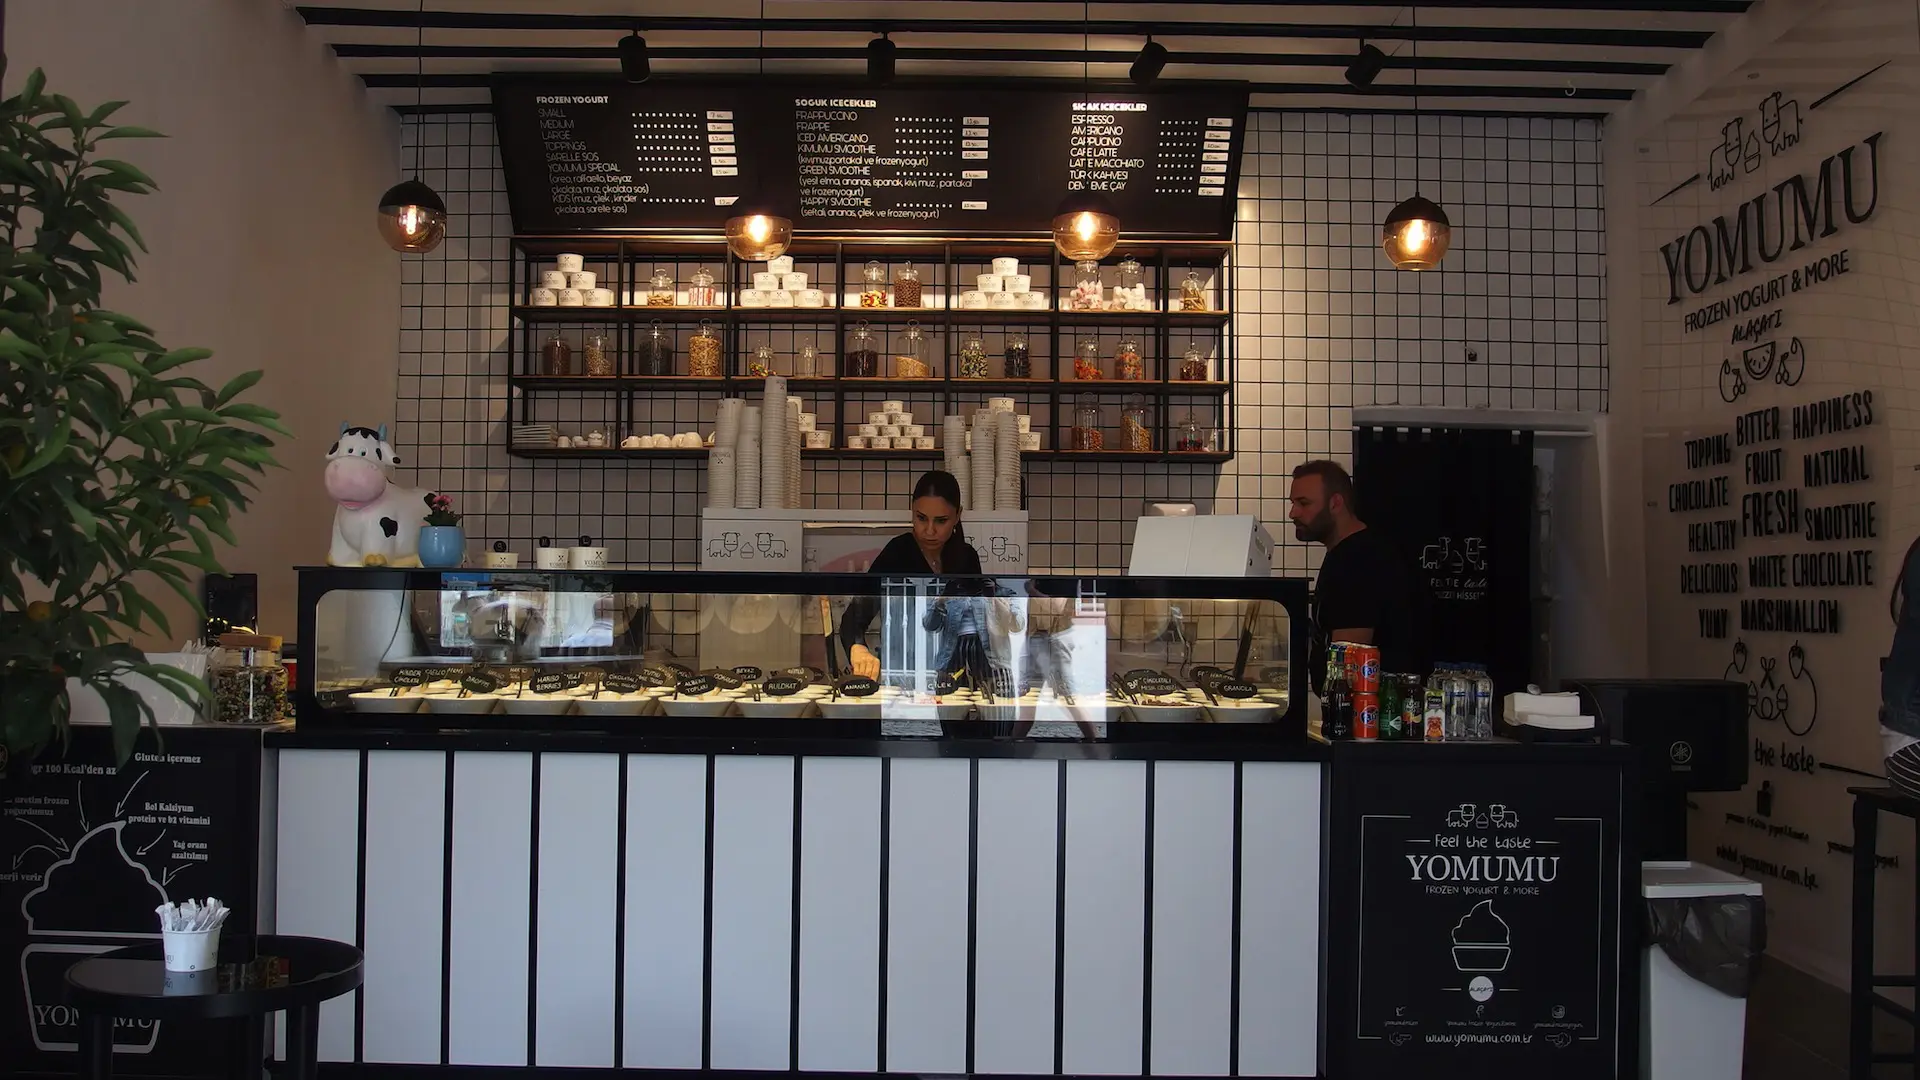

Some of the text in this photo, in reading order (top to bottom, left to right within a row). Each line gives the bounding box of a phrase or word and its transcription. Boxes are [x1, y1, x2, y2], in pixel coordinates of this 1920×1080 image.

[536, 95, 609, 104] FROZEN YOGURT
[795, 99, 877, 108] SOGUK ICECEKLER
[1072, 102, 1148, 112] SICAK ICECEKLER
[538, 108, 567, 118] SMALL
[795, 111, 858, 121] FRAPPUCCINO
[539, 119, 575, 129] MEDIUM
[1071, 115, 1115, 124] ESPRESSO
[796, 122, 830, 131] FRAPPE
[1071, 126, 1124, 136] AMERICANO
[541, 130, 572, 140] LARGE
[797, 133, 869, 143] ICED AMERICANO
[544, 141, 587, 151] TOPPINGS
[797, 144, 877, 154] KIMUMU SMOOTHIE
[546, 152, 600, 162] SARELLE SOS
[1070, 147, 1118, 157] CAFE LATTE
[864, 157, 874, 165] ve
[1069, 158, 1145, 168] LATTE MACCHIATO
[547, 163, 621, 172] YOMUMU SPECIAL
[799, 166, 871, 176] GREEN SMOOTHIE
[606, 174, 632, 185] beyaz
[939, 178, 972, 189] portakal
[800, 188, 810, 196] ve
[1109, 181, 1127, 192] ÇAY
[552, 194, 571, 203] KIDS
[613, 194, 637, 203] kinder
[800, 197, 872, 207] HAPPY SMOOTHIE
[586, 204, 611, 213] sarelle
[612, 203, 628, 214] sos)
[1659, 131, 1883, 306] YOMUMU
[1685, 249, 1849, 334] FROZEN YOGURT & MORE
[1792, 390, 1873, 440] HAPPINESS
[1736, 406, 1780, 447] BITTER
[1685, 432, 1731, 470] TOPPING
[1745, 448, 1782, 485] FRUIT
[1803, 445, 1870, 488] NATURAL
[1669, 475, 1729, 513] CHOCOLATE
[1742, 488, 1799, 537] FRESH
[1804, 501, 1877, 542] SMOOTHIE
[1688, 519, 1737, 552] HEALTHY
[1748, 550, 1874, 588] WHITE CHOCOLATE
[1680, 563, 1738, 594] DELICIOUS
[1740, 598, 1839, 634] MARSHMALLOW
[1754, 737, 1814, 775] the taste
[63, 763, 104, 775] Kcal'den
[105, 767, 117, 775] az
[43, 795, 70, 805] frozen
[144, 802, 195, 814] Bol Kalsiyum
[128, 814, 156, 824] protein
[167, 815, 177, 824] b2
[178, 816, 211, 825] vitamini
[172, 840, 208, 850] Yağ oranı
[1434, 833, 1532, 850] Feel the taste
[1405, 854, 1561, 882] YOMUMU
[20, 872, 43, 882] verir
[1425, 885, 1540, 896] FROZEN YOGURT & MORE
[1425, 1033, 1533, 1048] www.yomumu.com.tr
